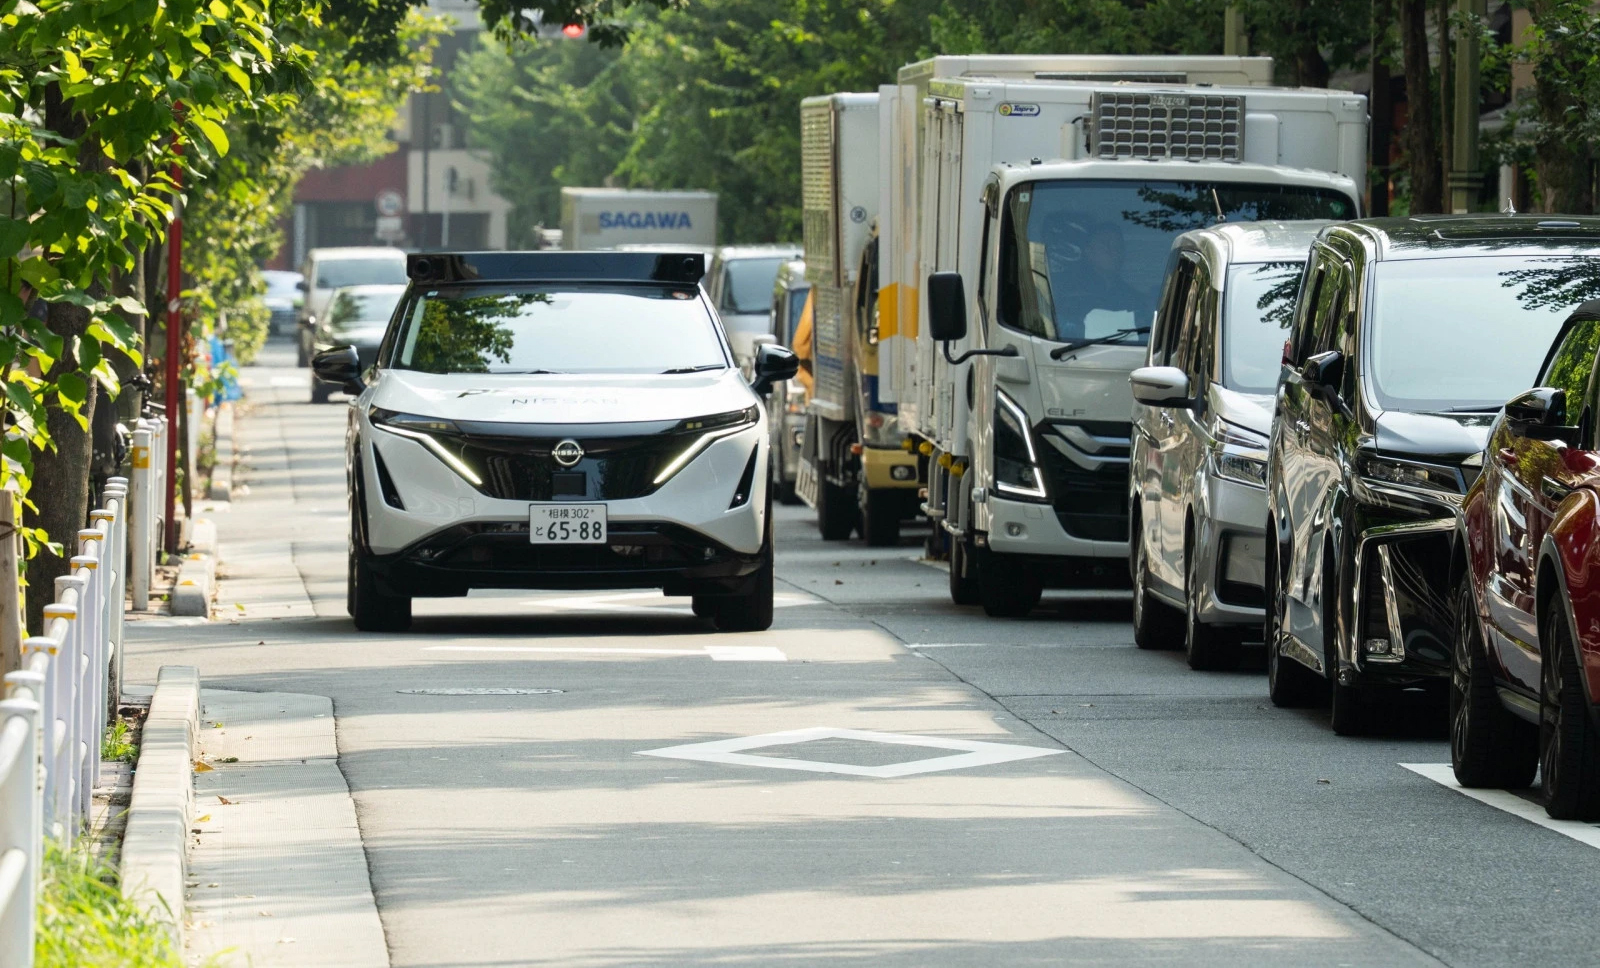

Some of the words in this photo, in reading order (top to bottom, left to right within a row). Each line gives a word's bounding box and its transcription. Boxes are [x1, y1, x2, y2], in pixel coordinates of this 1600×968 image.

[599, 211, 692, 229] SAGAWA
[1047, 407, 1086, 417] ELF
[547, 521, 602, 540] 65-88
